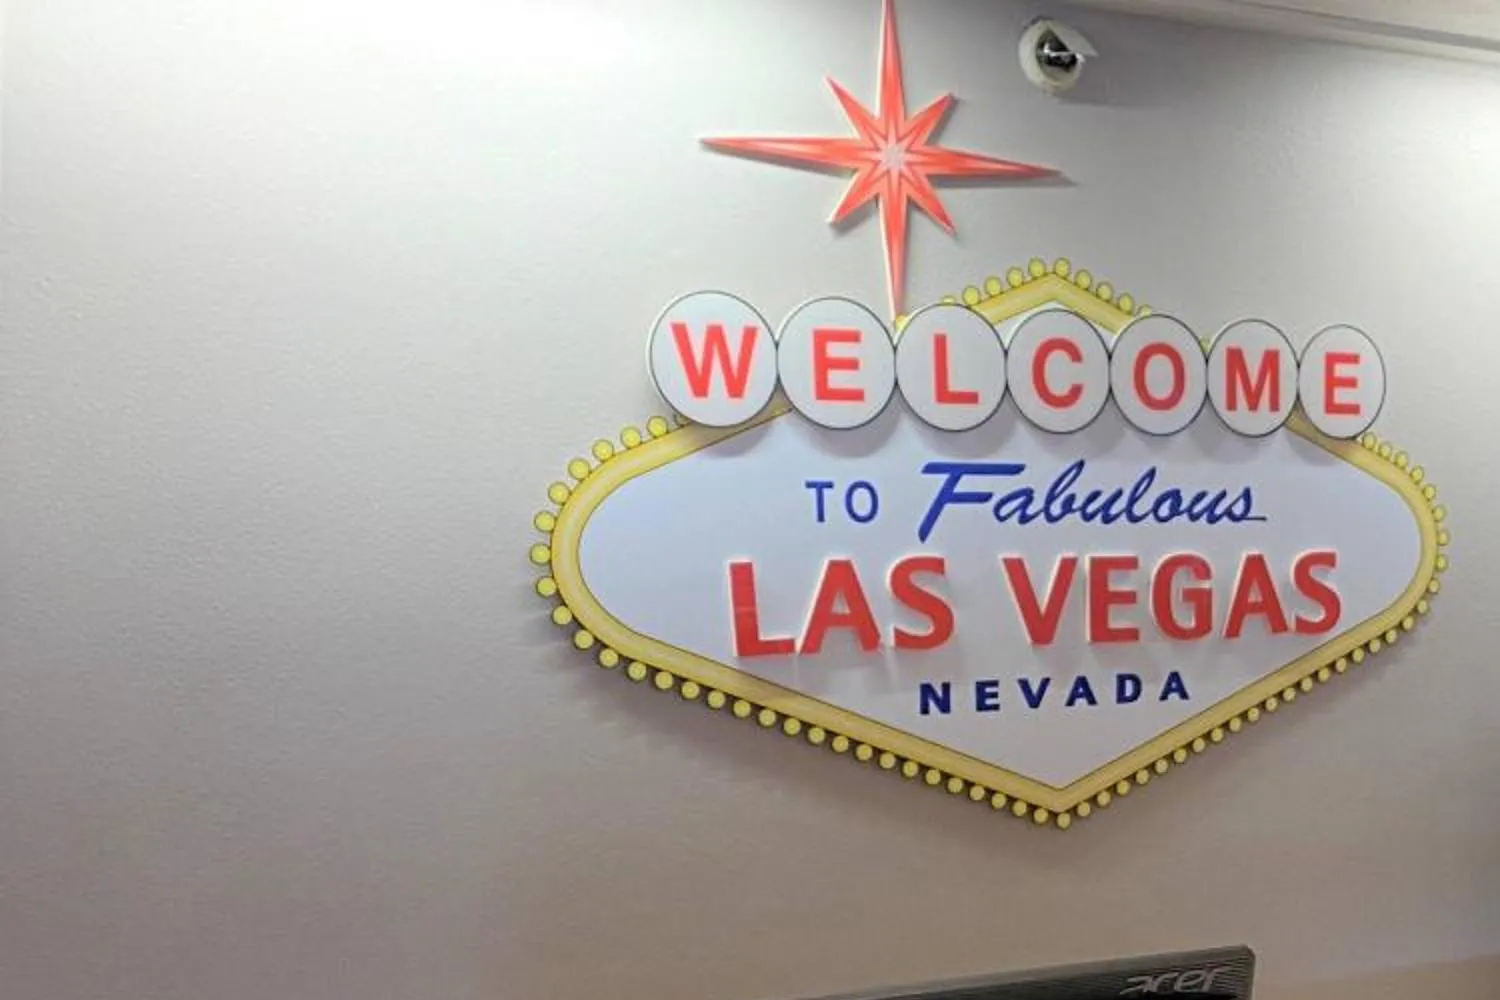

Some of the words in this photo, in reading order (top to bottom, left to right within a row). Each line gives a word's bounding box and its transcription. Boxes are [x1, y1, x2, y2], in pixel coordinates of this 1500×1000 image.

[671, 321, 1363, 417] WELCOME
[804, 479, 881, 524] TO
[916, 458, 1266, 544] Fabulous
[728, 556, 956, 659] LAS
[1004, 551, 1342, 648] VEGAS
[919, 671, 1191, 716] NEVADA
[1119, 964, 1232, 995] acer
